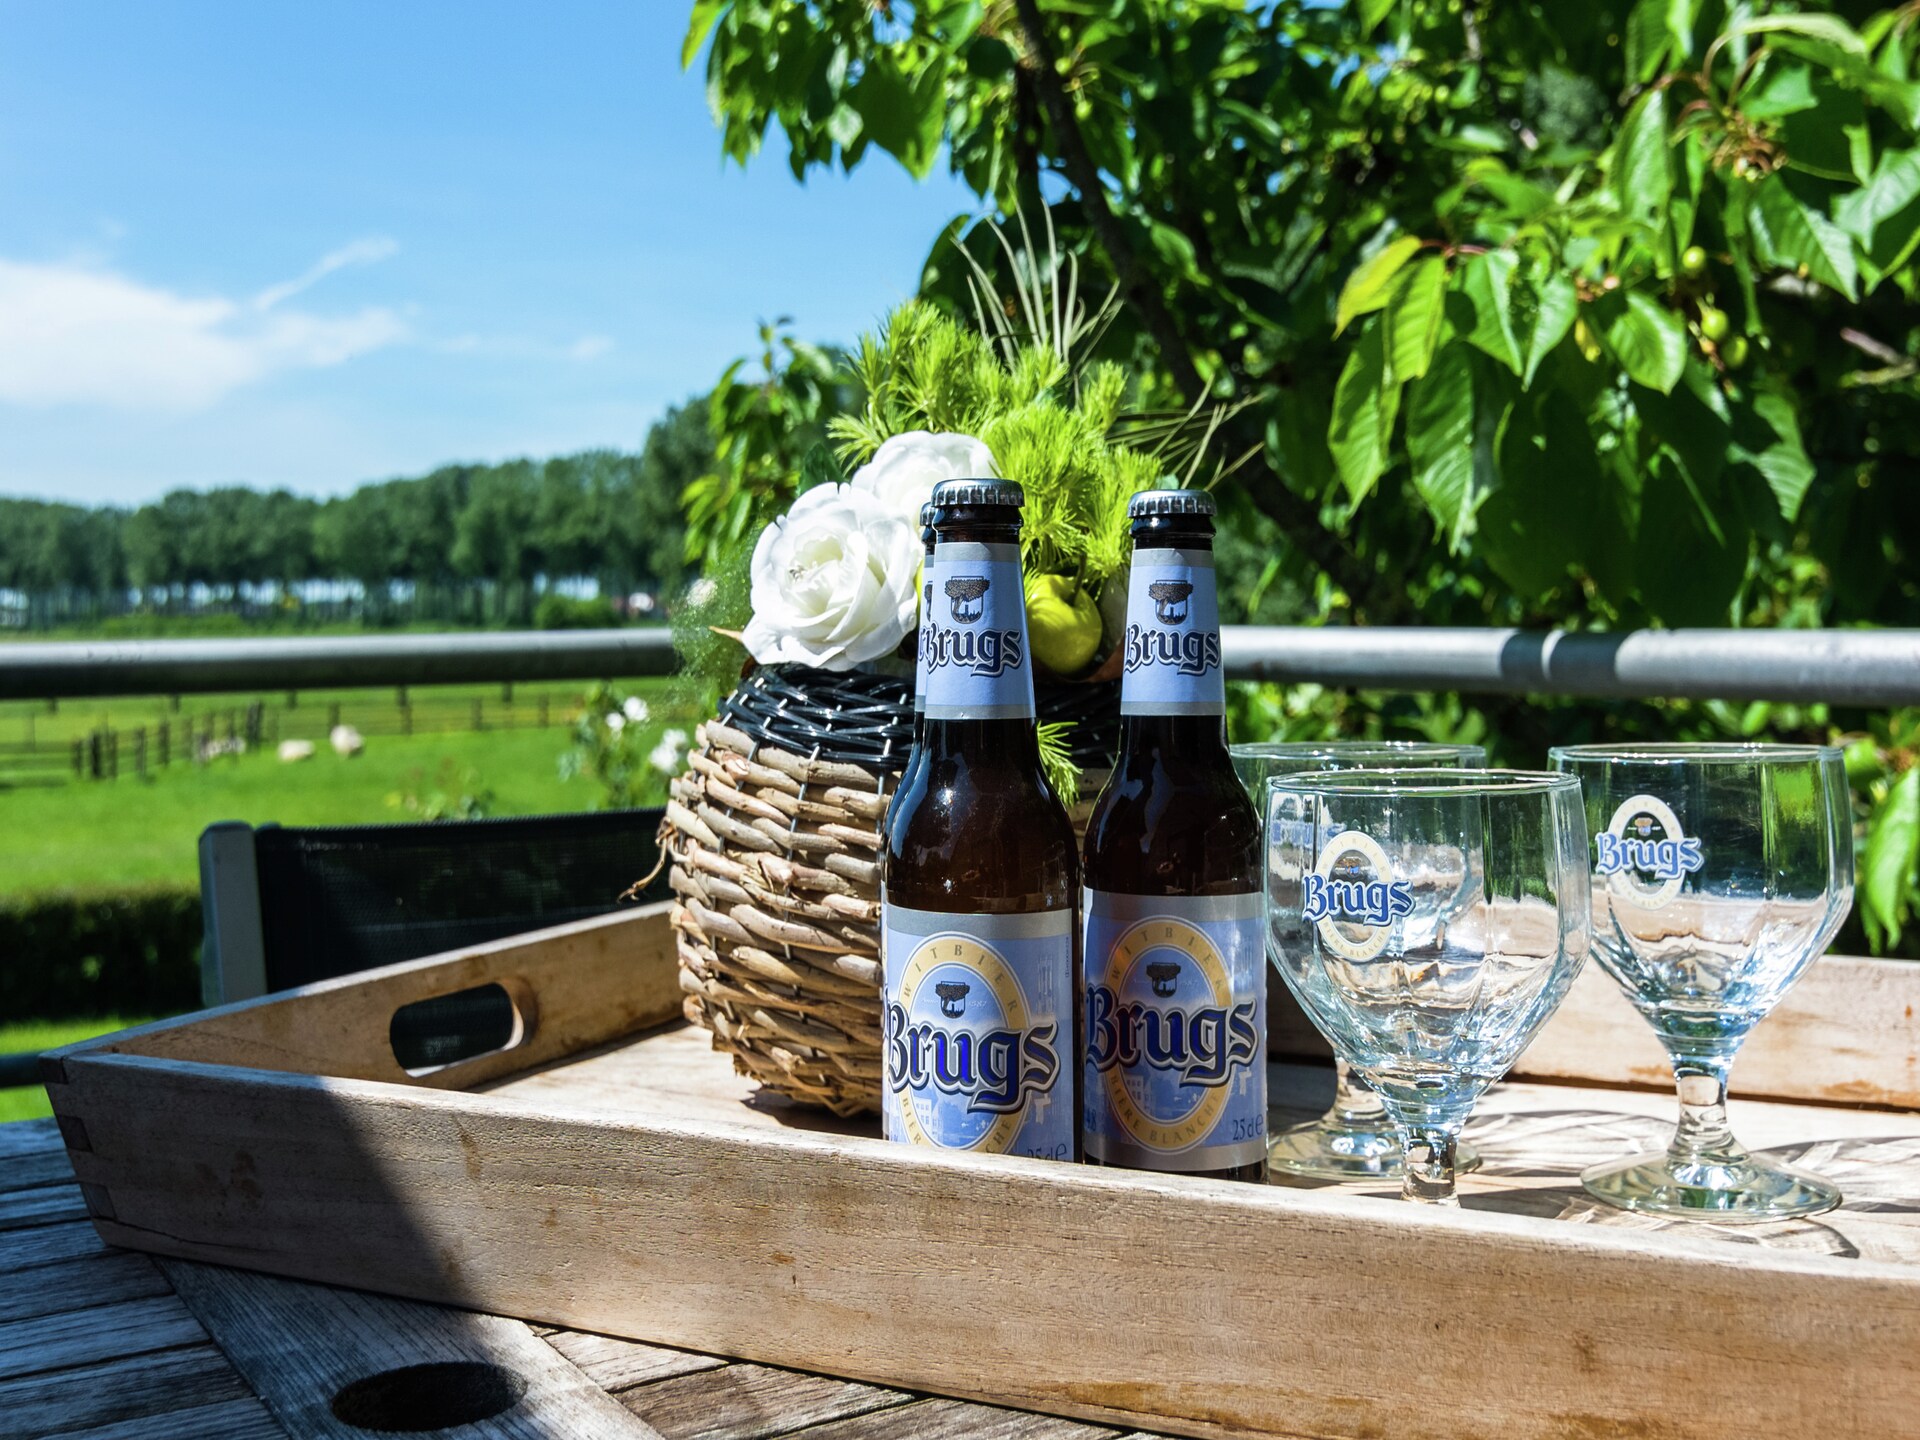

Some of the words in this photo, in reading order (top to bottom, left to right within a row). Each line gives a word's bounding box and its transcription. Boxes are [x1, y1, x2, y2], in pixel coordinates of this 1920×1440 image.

[926, 621, 1023, 678] Brugs
[1124, 622, 1220, 677] Brugs
[1595, 832, 1704, 880] Brugs
[1302, 874, 1416, 927] Brugs
[903, 943, 1018, 1013] WITBIER
[888, 1001, 1061, 1115] Brugs
[1086, 985, 1259, 1088] Brugs
